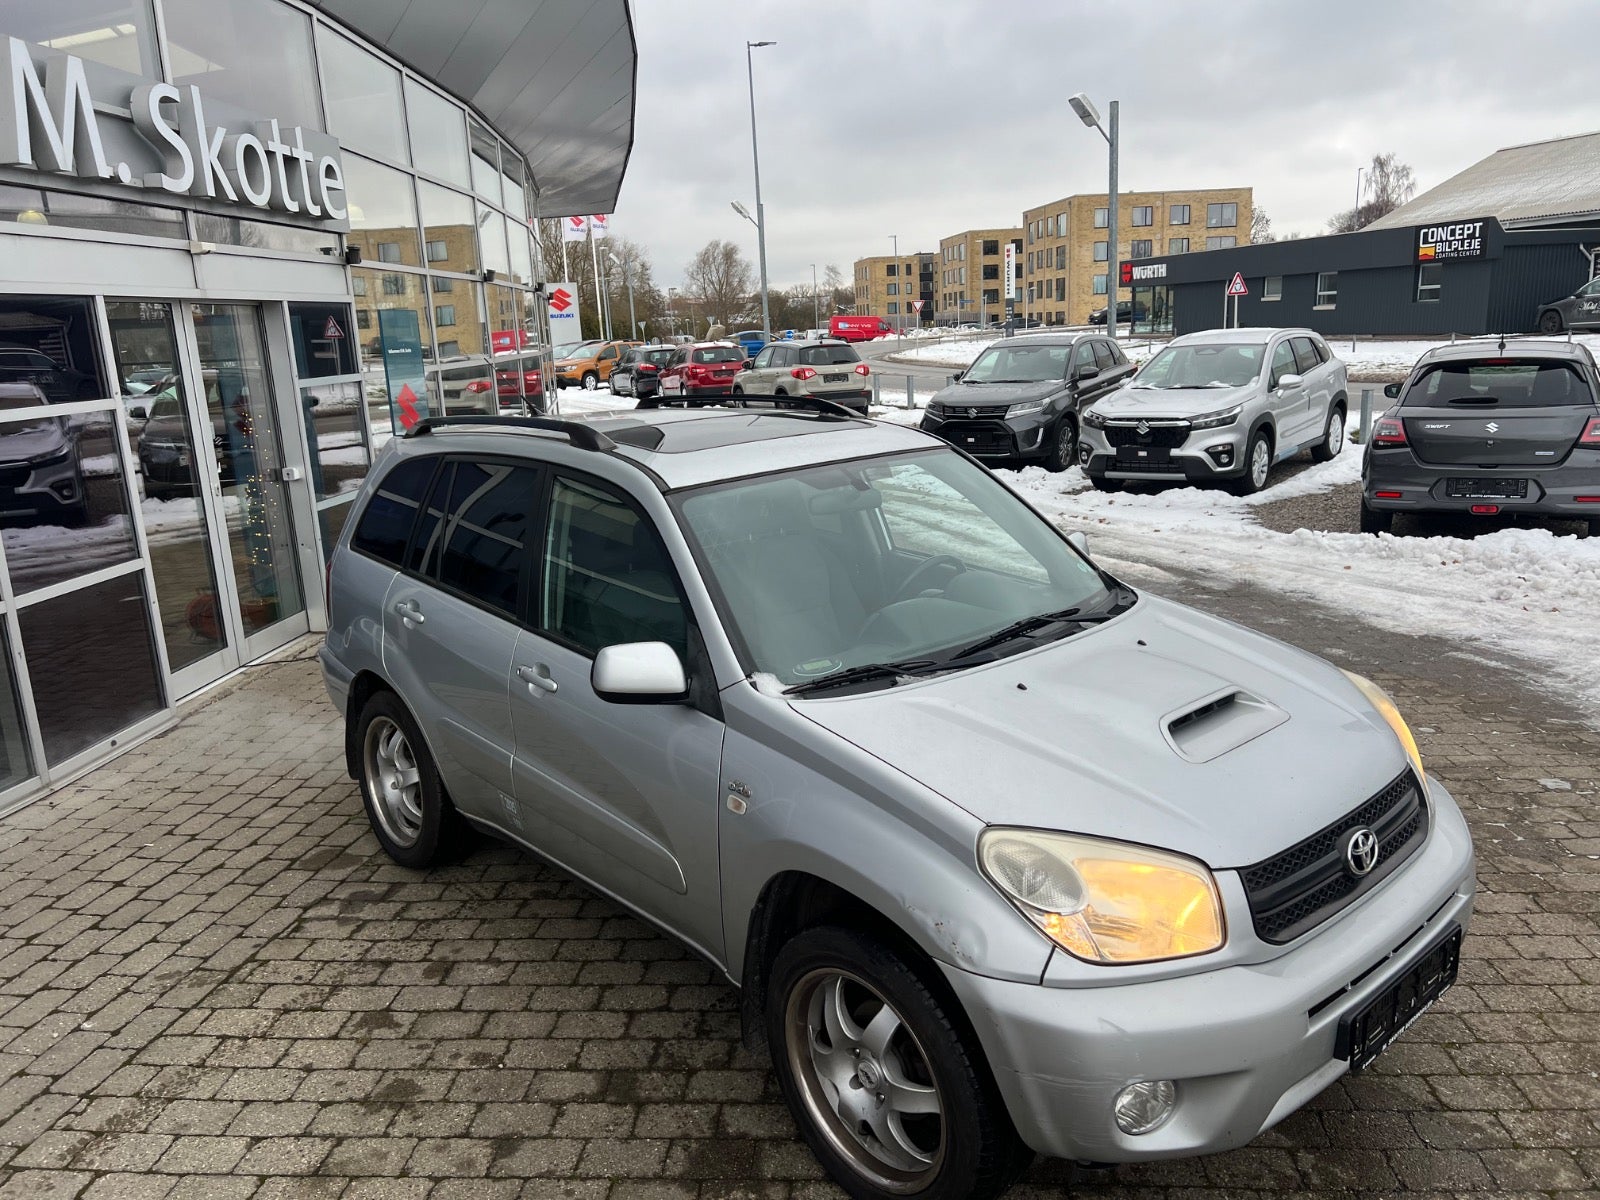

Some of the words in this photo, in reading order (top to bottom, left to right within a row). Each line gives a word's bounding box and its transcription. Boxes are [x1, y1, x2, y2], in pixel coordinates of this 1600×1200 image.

[8, 35, 132, 184] M.
[148, 82, 348, 220] Skotte
[1419, 222, 1483, 248] CONCEPT
[1435, 238, 1482, 253] BILPLEJE
[1435, 251, 1458, 259] COATING
[1459, 249, 1481, 257] CENTER
